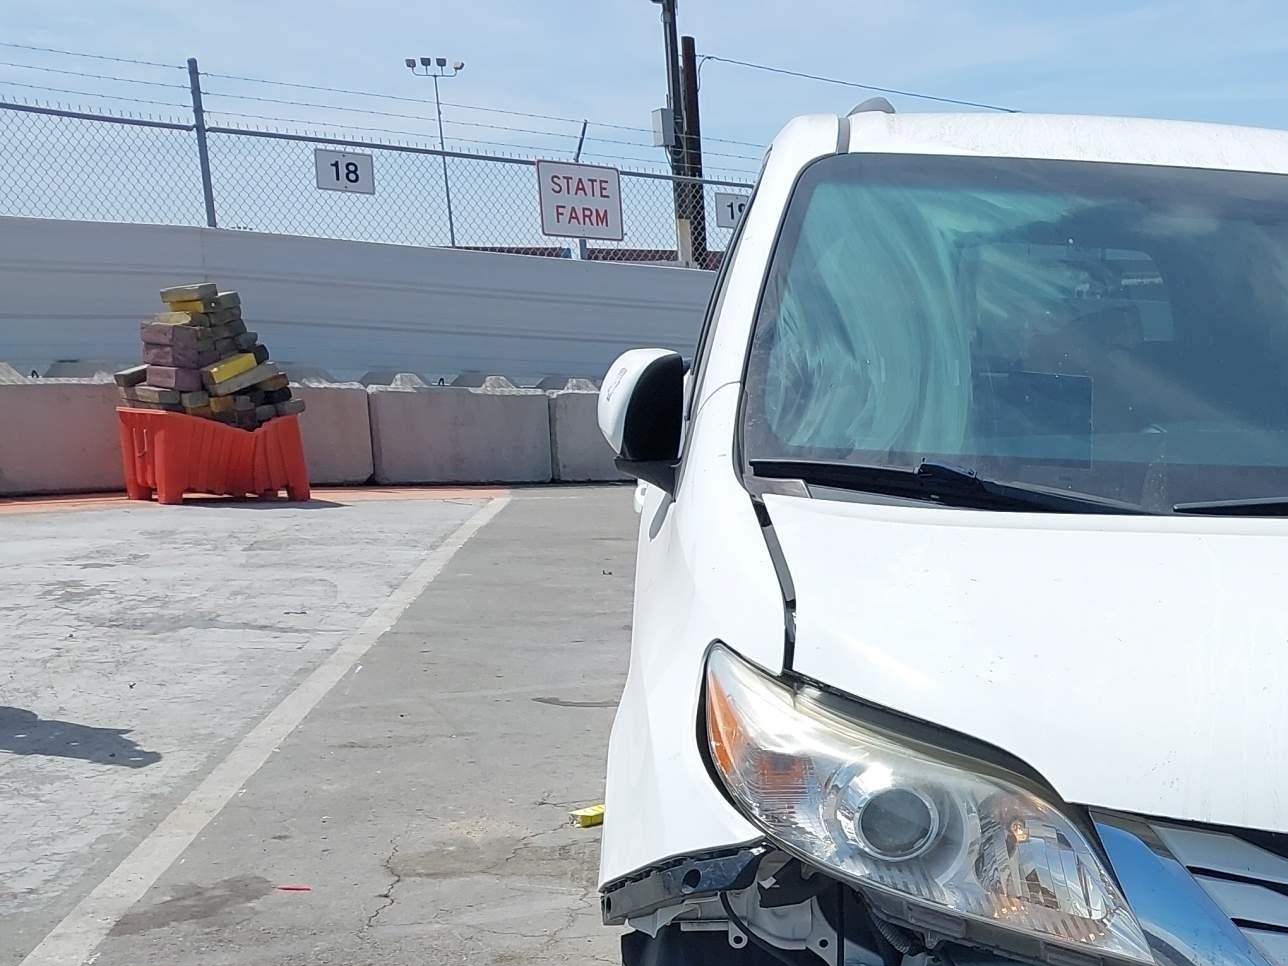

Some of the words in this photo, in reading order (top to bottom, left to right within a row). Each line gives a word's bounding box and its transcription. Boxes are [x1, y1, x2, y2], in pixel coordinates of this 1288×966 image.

[329, 159, 360, 184] 18
[550, 174, 611, 199] STATE
[555, 205, 610, 227] FARM
